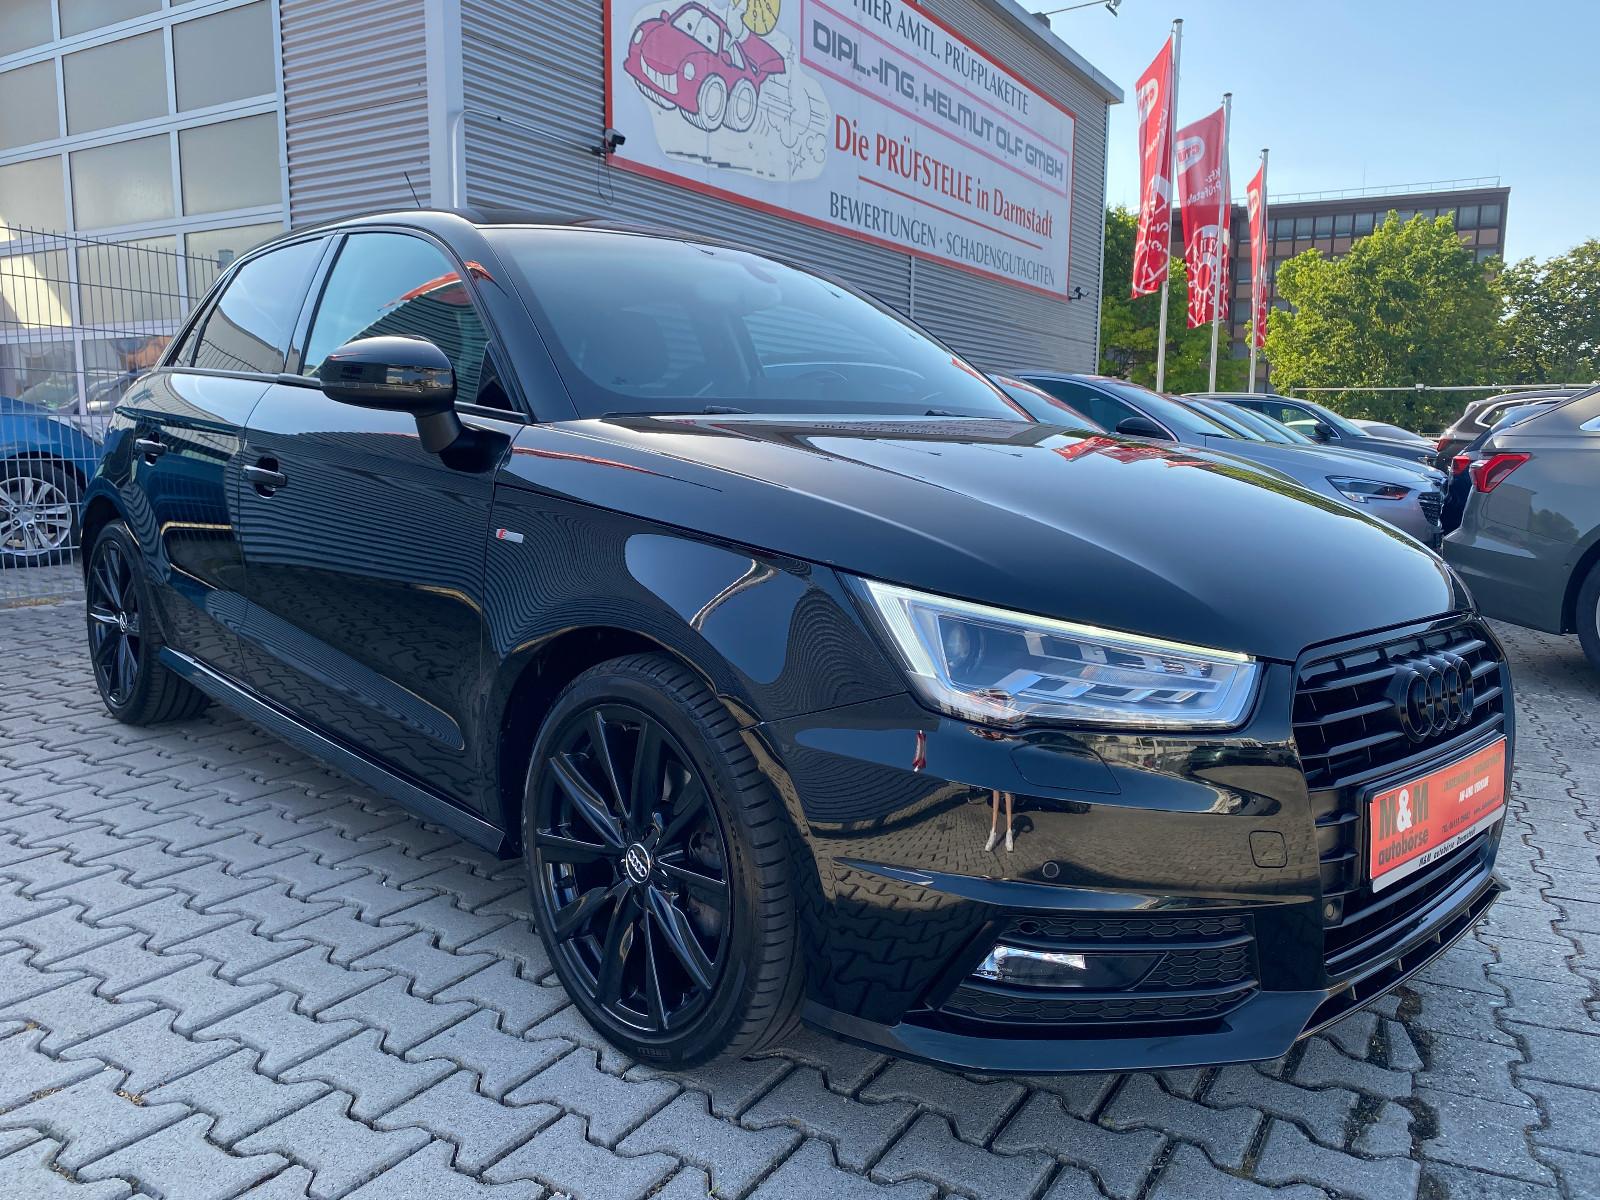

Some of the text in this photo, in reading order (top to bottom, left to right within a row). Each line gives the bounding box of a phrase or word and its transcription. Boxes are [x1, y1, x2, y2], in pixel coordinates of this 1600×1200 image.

[813, 19, 920, 103] DIPL.-ING.
[923, 83, 994, 141] HELMUT
[996, 125, 1023, 157] OLF
[896, 10, 940, 60] AMTL.
[945, 40, 1029, 116] PRÜFPLAKETTE
[835, 114, 1053, 239] Die PRÜFSTELLE in Darmstadt
[830, 191, 1055, 286] BEWERTUNGEN SCHADENSGUTACHTEN
[1378, 782, 1430, 841] M&M
[1378, 827, 1430, 866] autobörse
